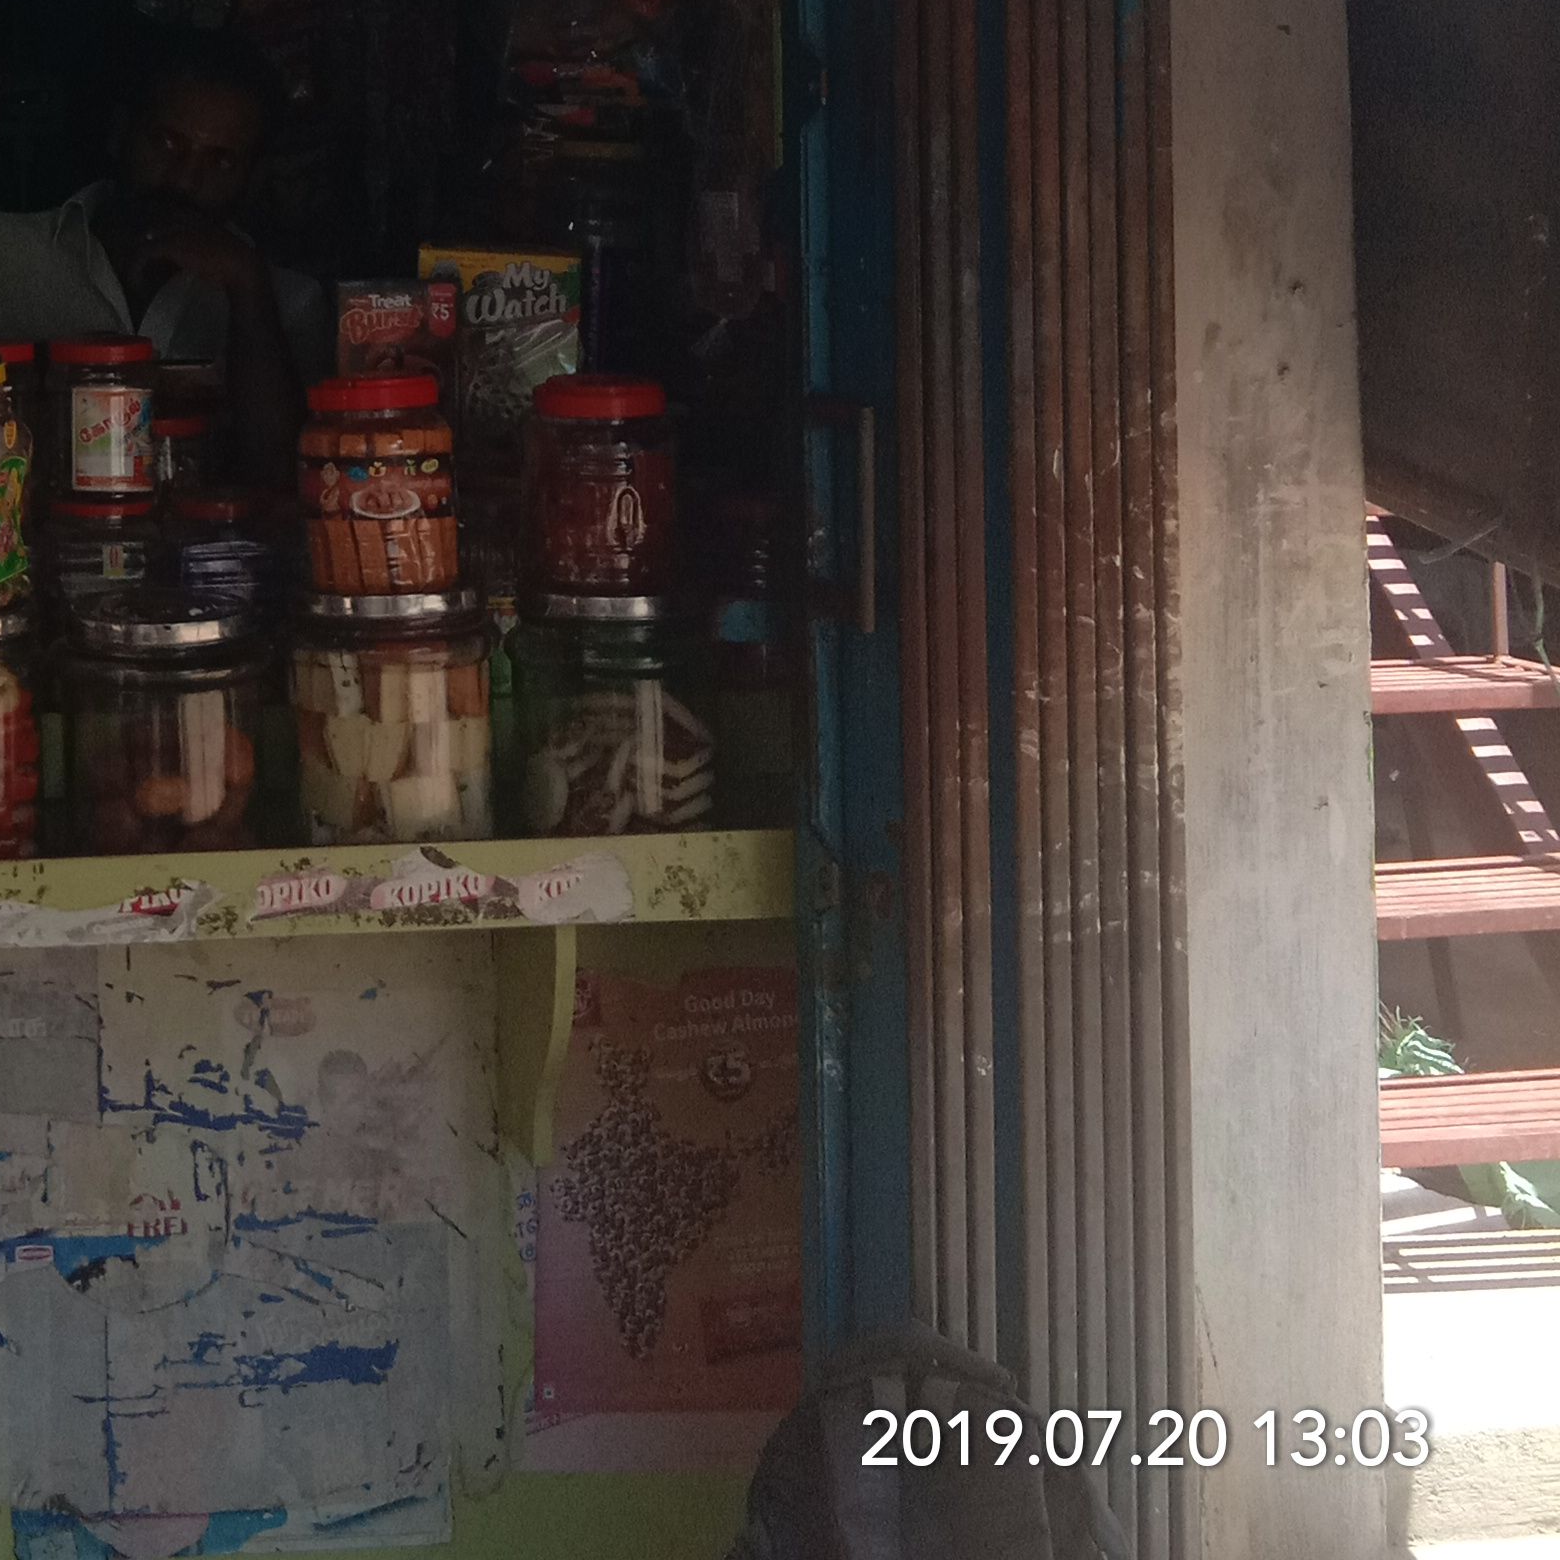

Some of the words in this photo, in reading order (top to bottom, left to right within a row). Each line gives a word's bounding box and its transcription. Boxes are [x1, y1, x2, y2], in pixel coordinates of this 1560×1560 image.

[502, 261, 551, 291] My
[368, 294, 413, 309] Treat
[465, 283, 568, 324] Watch
[684, 993, 735, 1013] Good
[741, 988, 775, 1009] Day
[654, 1020, 728, 1041] Cashew
[731, 1013, 797, 1033] Almon
